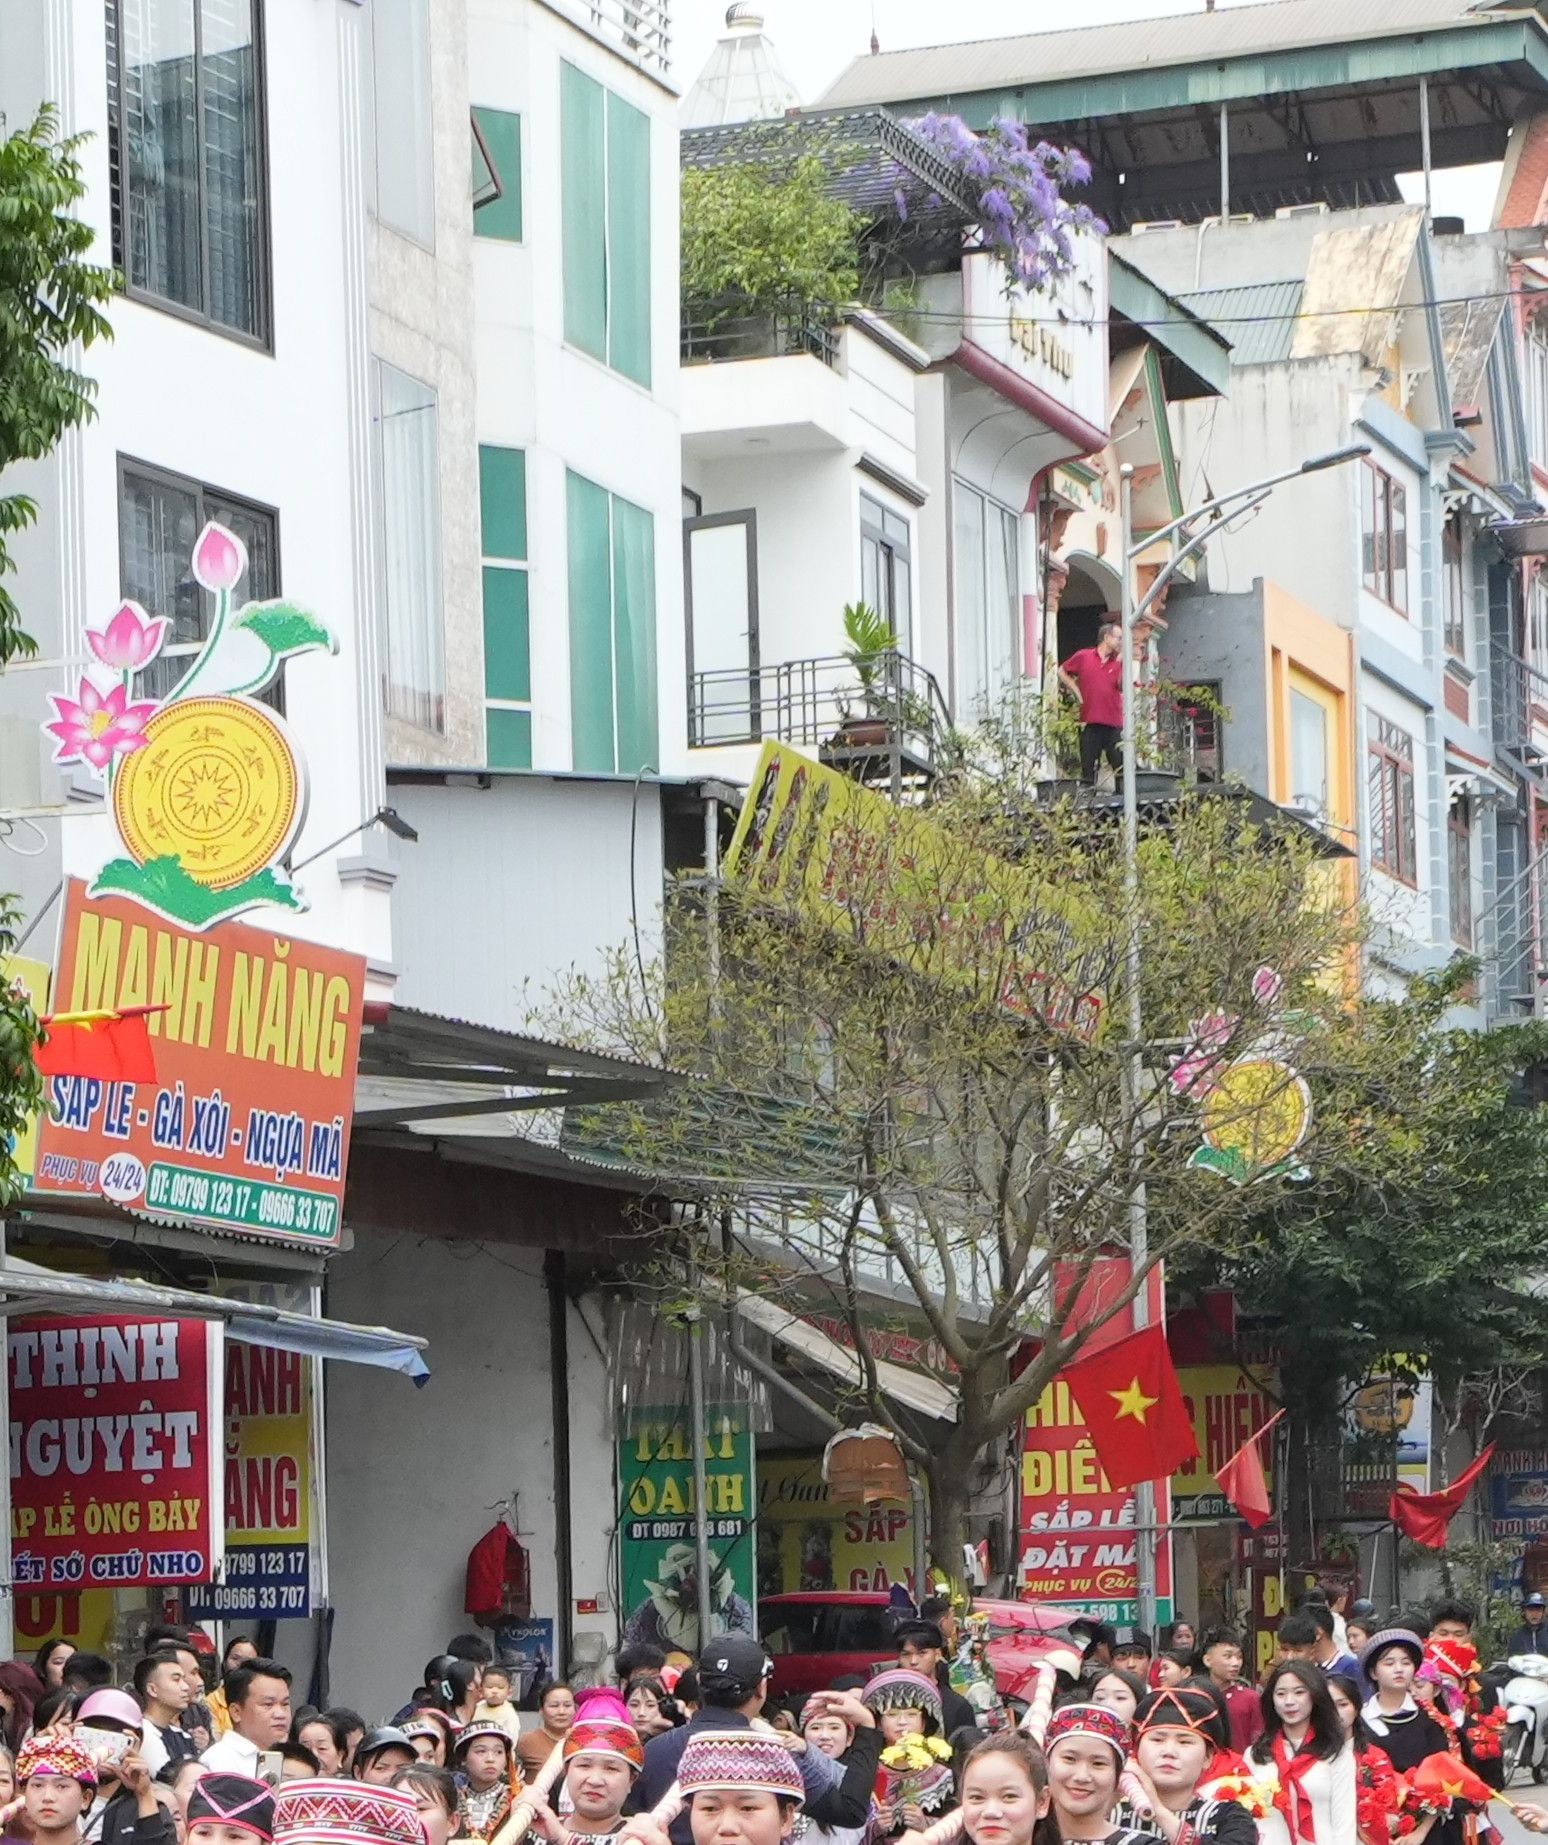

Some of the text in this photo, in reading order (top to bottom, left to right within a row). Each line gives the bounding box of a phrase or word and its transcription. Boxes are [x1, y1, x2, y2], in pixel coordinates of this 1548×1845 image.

[226, 938, 350, 1078] NĂNG
[152, 1081, 185, 1150] GÀ
[187, 1089, 230, 1159] XÔI
[244, 1110, 303, 1182] NGỰA
[309, 1116, 343, 1182] MÃ
[40, 1153, 142, 1193] PHỤC VỤ 24/24
[170, 1170, 209, 1211] 09799
[211, 1179, 234, 1215] 123
[235, 1182, 251, 1218] 17
[258, 1188, 293, 1227] 09666
[295, 1194, 311, 1230] 33
[312, 1197, 335, 1233] 707
[9, 1321, 180, 1399] THỊNH
[45, 1491, 76, 1537] LỄ
[84, 1496, 140, 1536] ÔNG
[148, 1491, 201, 1532] BẢY
[653, 1521, 686, 1538] 0987
[718, 1519, 742, 1536] 681
[1030, 1499, 1093, 1530] SẮP
[51, 1550, 86, 1582] SỚ
[147, 1551, 203, 1579] NHO
[259, 1552, 284, 1574] 123
[288, 1551, 305, 1574] 17
[1022, 1540, 1089, 1575] ĐẶT
[215, 1587, 257, 1610] 09666
[260, 1587, 277, 1609] 33
[280, 1586, 305, 1608] 707
[1070, 1576, 1091, 1595] VỤ
